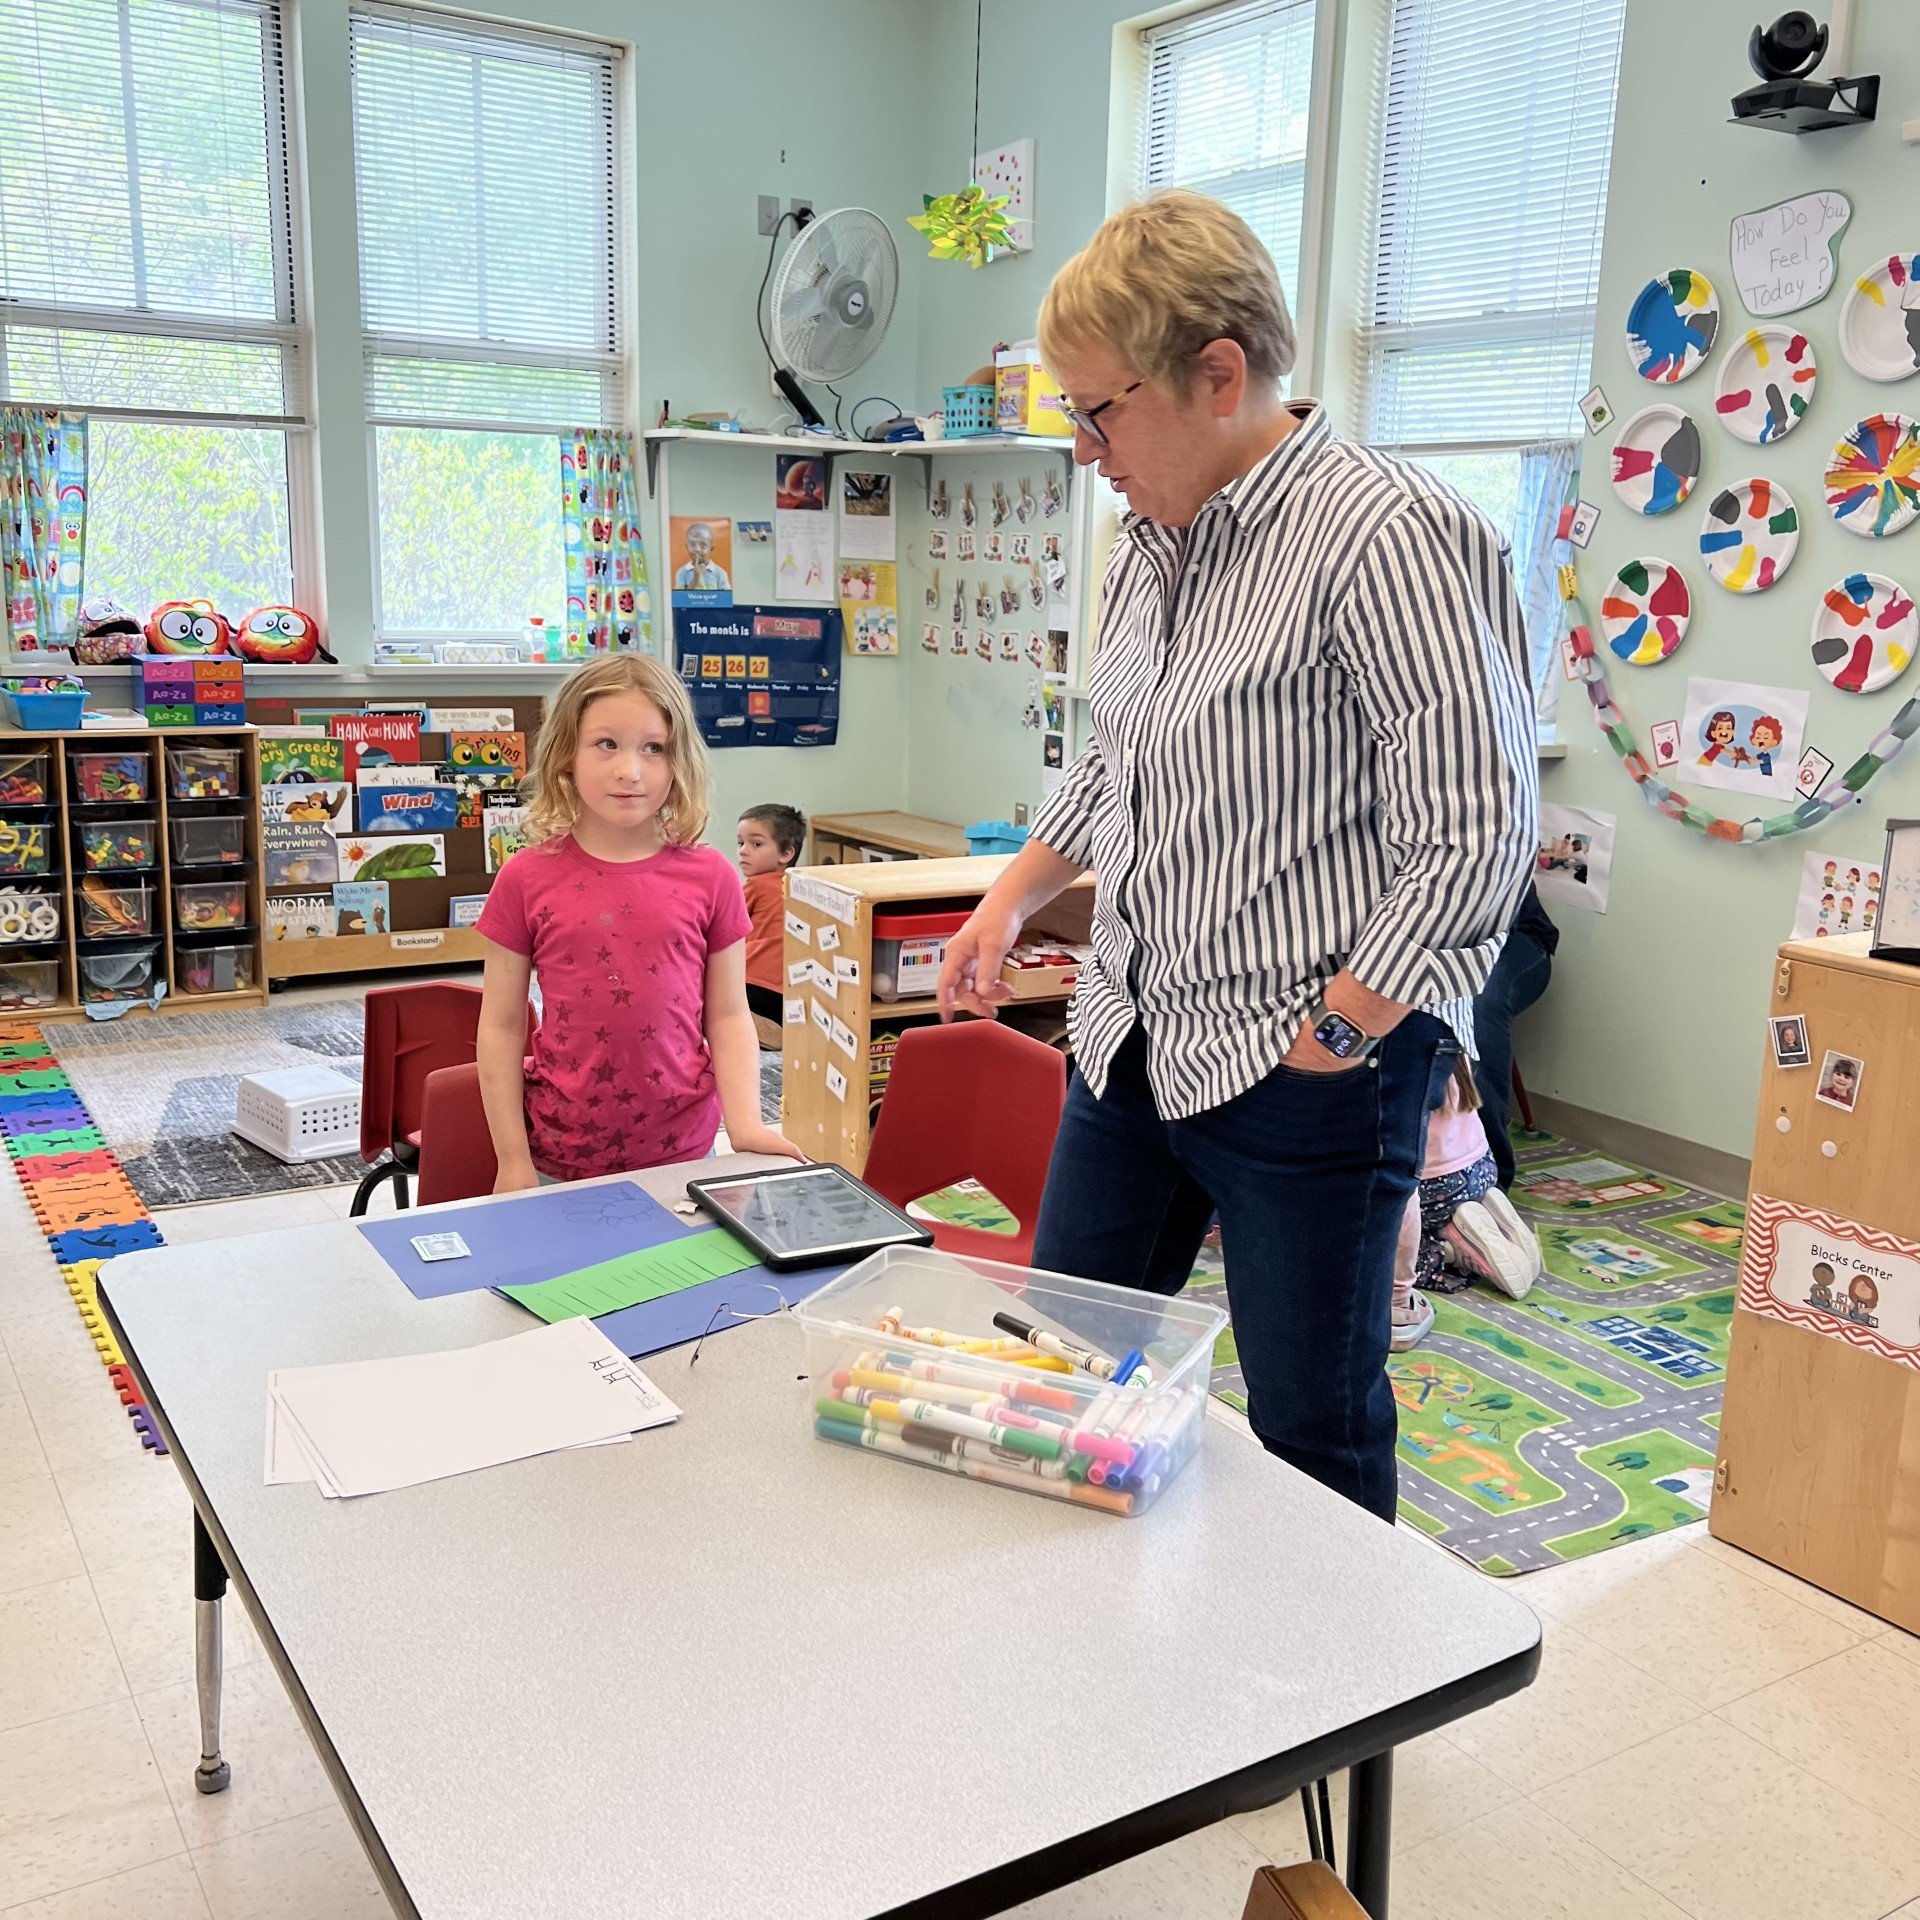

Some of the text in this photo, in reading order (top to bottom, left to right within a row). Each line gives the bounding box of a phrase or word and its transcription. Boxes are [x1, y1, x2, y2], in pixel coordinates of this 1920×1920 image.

[1736, 195, 1847, 253] How Do You
[1769, 236, 1809, 273] Feel
[1744, 278, 1805, 310] Today
[689, 622, 749, 636] The month is
[774, 619, 800, 634] May
[704, 661, 766, 673] 25 26 27
[153, 690, 187, 699] Aa-Zz
[203, 690, 236, 699] Aa-Zz
[154, 712, 188, 721] Aa-Zz
[203, 711, 237, 721] Aa-Zz
[336, 722, 369, 741] HANK
[383, 722, 415, 740] HONK
[288, 741, 339, 757] Greedy
[311, 753, 337, 768] Bee
[382, 792, 434, 811] Wind
[266, 898, 326, 914] WORM
[270, 914, 327, 925] WEATHER
[397, 935, 438, 946] Bookstand
[1811, 1244, 1893, 1281] Blocks Center
